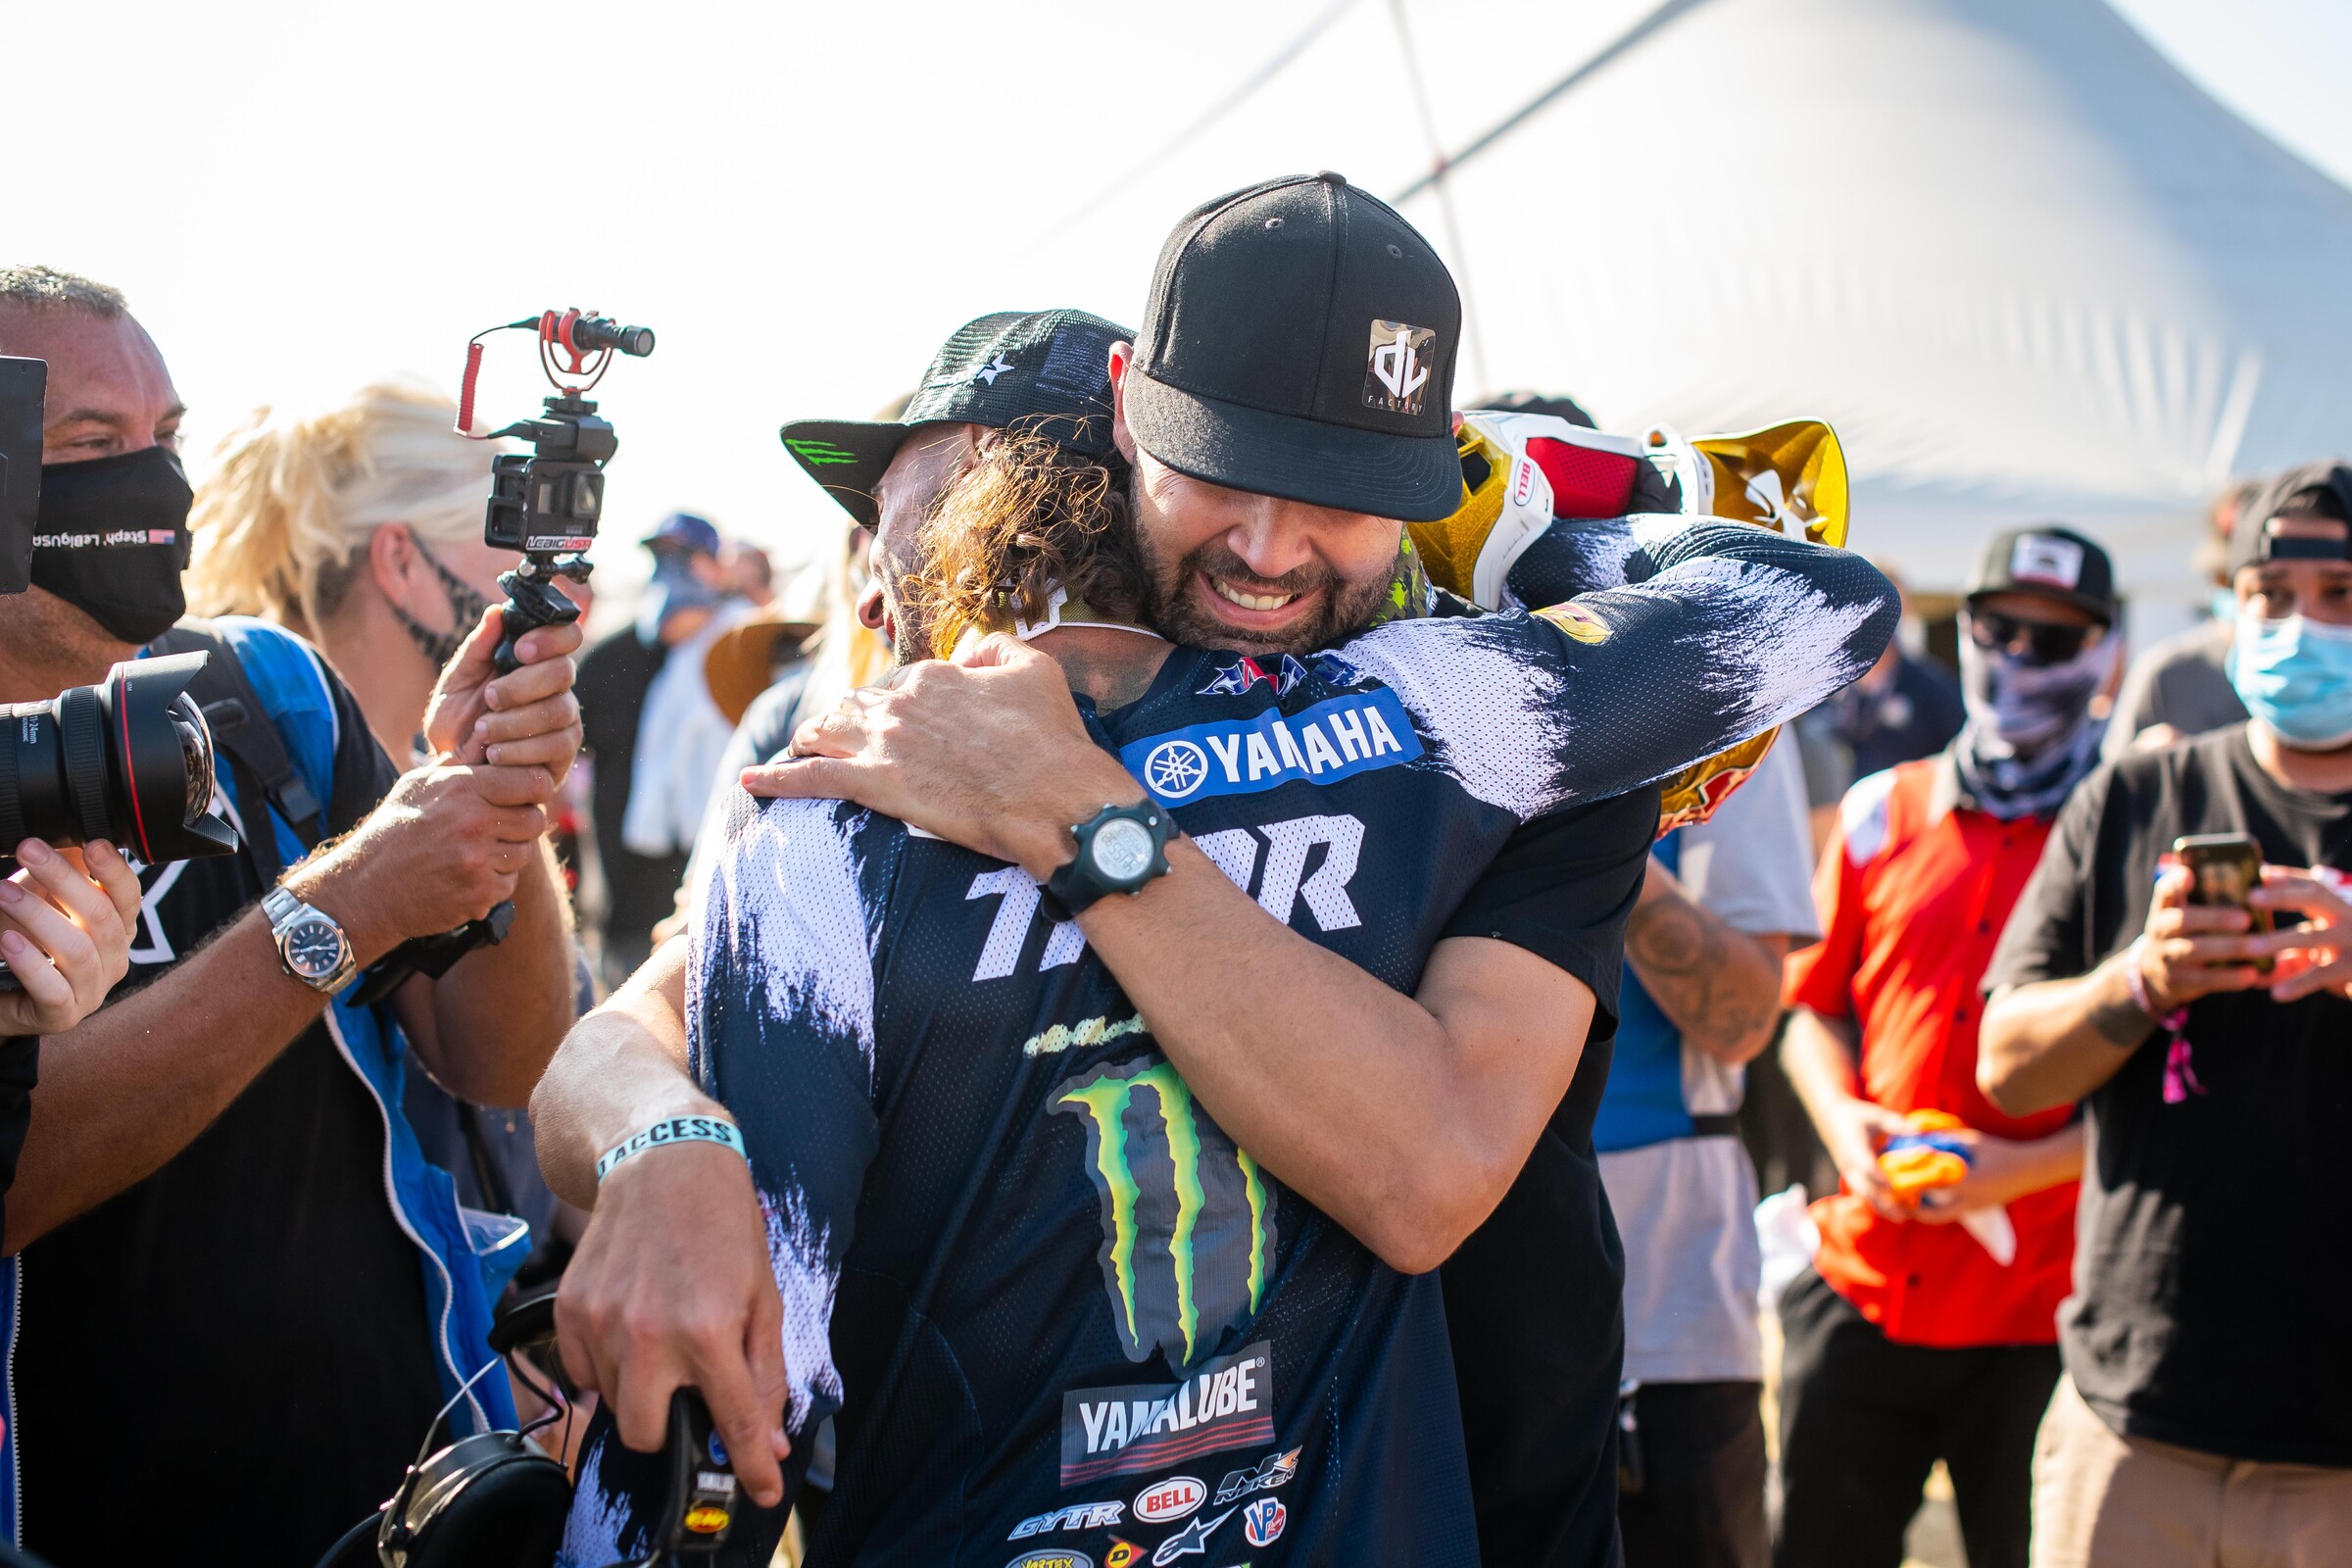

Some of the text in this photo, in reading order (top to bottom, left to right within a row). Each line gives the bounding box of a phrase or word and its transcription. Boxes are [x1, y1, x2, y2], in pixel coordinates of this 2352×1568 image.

[1367, 395, 1423, 413] FACTORY
[1517, 463, 1531, 498] BELL
[1205, 706, 1402, 782] YAMAHA
[613, 1118, 731, 1164] ACCESS
[1146, 1487, 1198, 1514] BELL
[1007, 1500, 1126, 1542] GYTR
